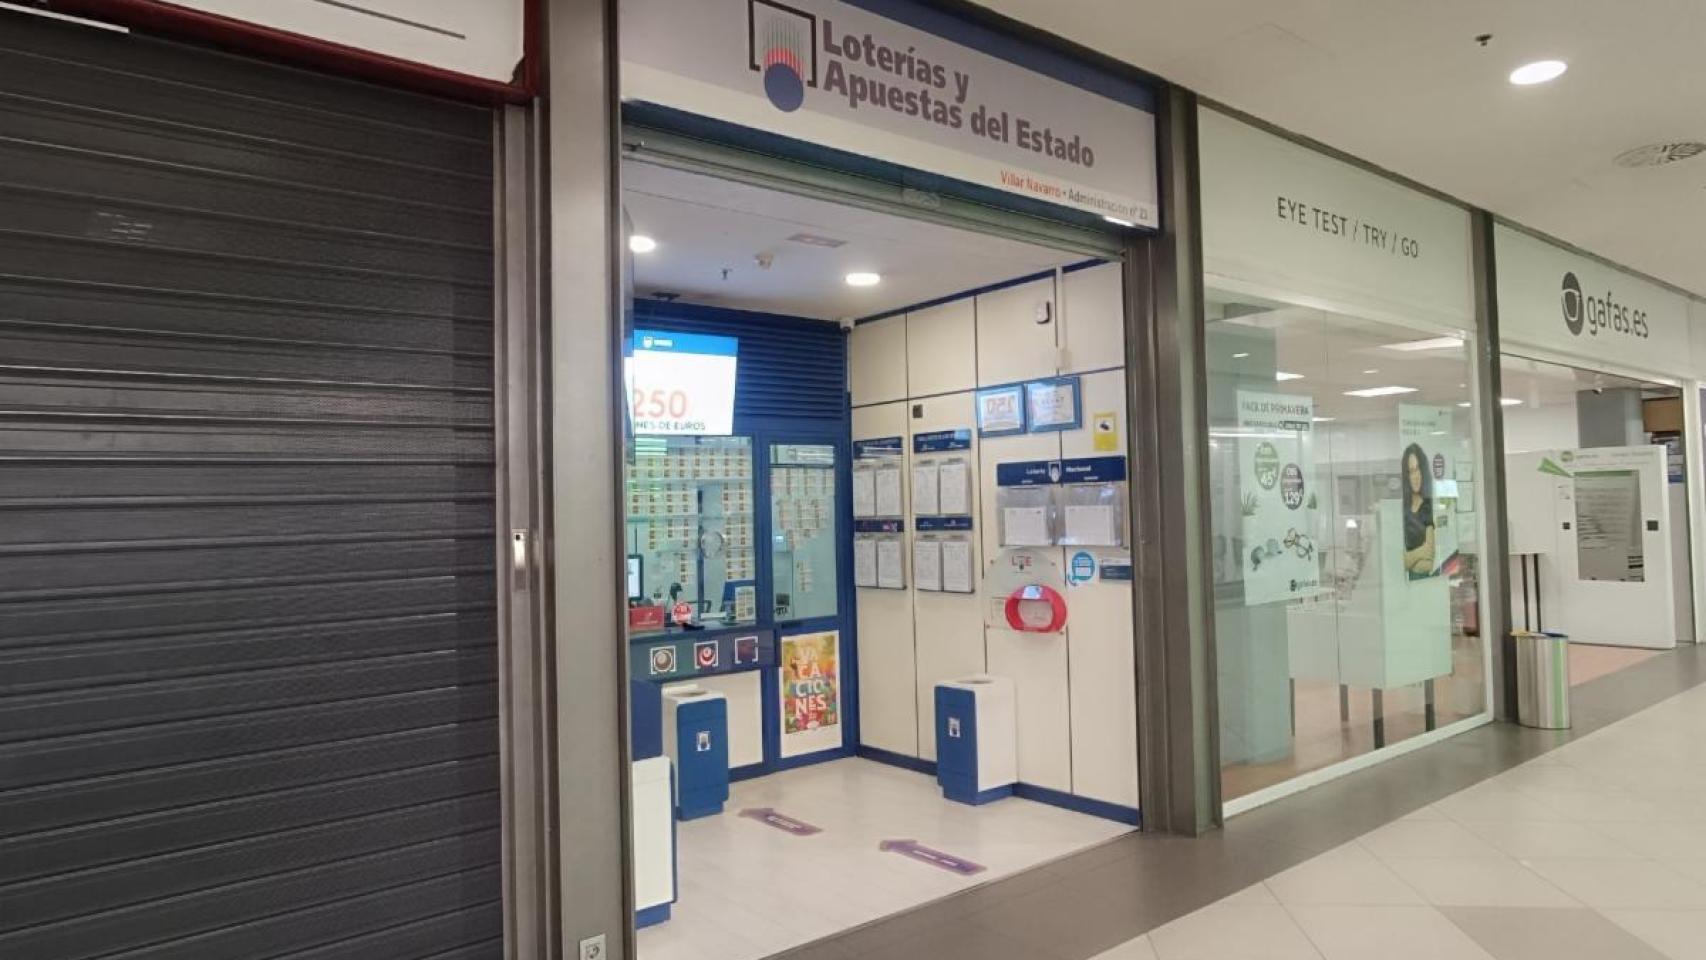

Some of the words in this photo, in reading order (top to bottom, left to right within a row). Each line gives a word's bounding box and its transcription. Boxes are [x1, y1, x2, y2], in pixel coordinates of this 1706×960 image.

[822, 20, 948, 89] Loterías
[954, 70, 970, 103] y
[823, 60, 963, 129] Apuestas
[971, 105, 1009, 143] del
[1016, 118, 1095, 169] Estado
[1001, 169, 1025, 188] Villar
[1027, 175, 1061, 198] Navarro
[1278, 196, 1307, 225] EYE
[1312, 207, 1348, 237] TEST
[1363, 223, 1387, 249] TRY
[1401, 237, 1418, 258] GO
[1586, 290, 1649, 339] gafas.es
[634, 388, 687, 418] 250
[659, 421, 670, 430] DE
[674, 421, 706, 431] EUROS
[795, 694, 827, 719] NES
